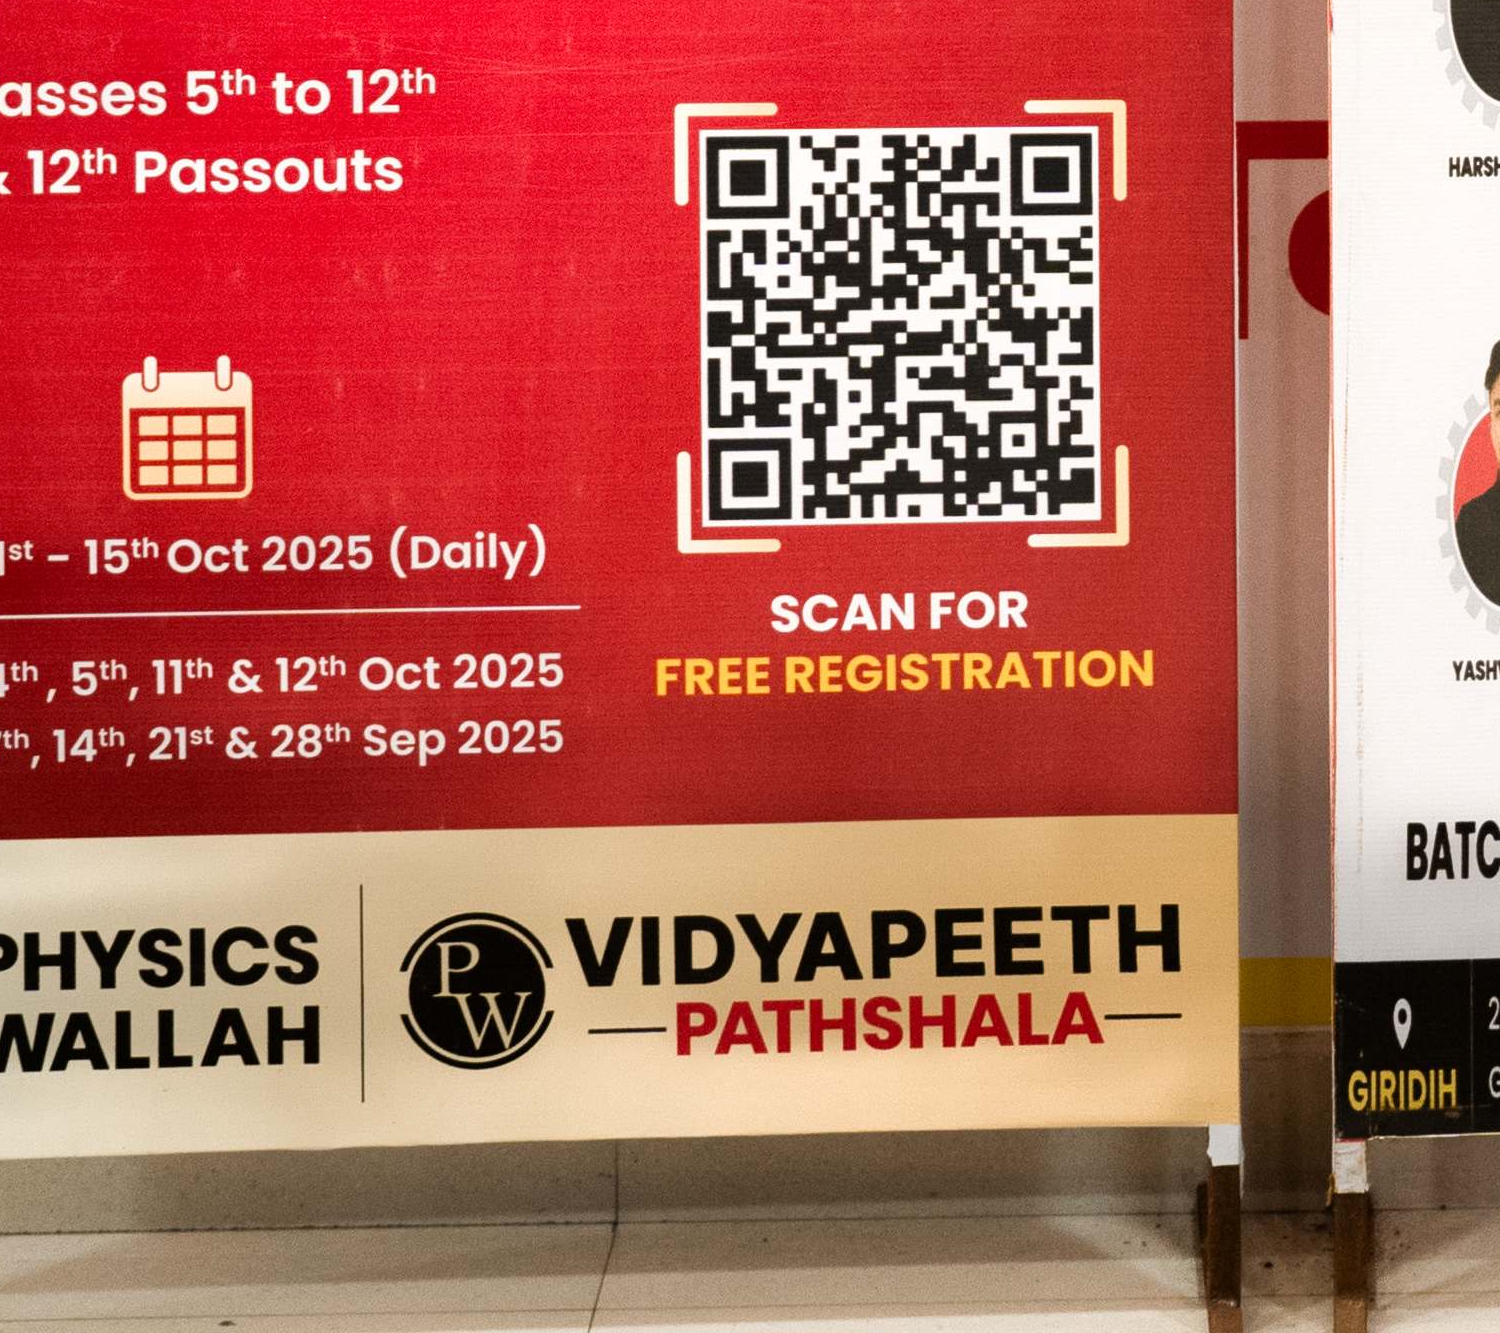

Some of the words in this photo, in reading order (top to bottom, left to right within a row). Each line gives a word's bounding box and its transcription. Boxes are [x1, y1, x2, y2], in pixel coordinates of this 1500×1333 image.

[186, 67, 257, 116] 5th
[270, 71, 332, 116] to
[346, 66, 437, 115] 12th
[26, 146, 118, 195] 12th
[134, 148, 404, 194] Passouts
[83, 536, 160, 575] 15th
[166, 538, 250, 574] Oct
[261, 534, 374, 572] 2025
[389, 523, 547, 581] (Daily)
[770, 592, 916, 634] SCAN
[929, 590, 1029, 630] FOR
[71, 658, 139, 702] 5th,
[151, 657, 214, 695] 11th
[274, 654, 347, 693] 12th
[358, 656, 441, 692] Oct
[453, 652, 564, 689] 2025
[656, 656, 771, 696] FREE
[785, 649, 1154, 694] REGISTRATION
[52, 726, 136, 768] 14th,
[148, 725, 214, 761] 21st
[270, 722, 351, 759] 28th
[363, 723, 447, 767] Sep
[457, 719, 564, 755] 2025
[1347, 1068, 1457, 1112] GIRIDIH
